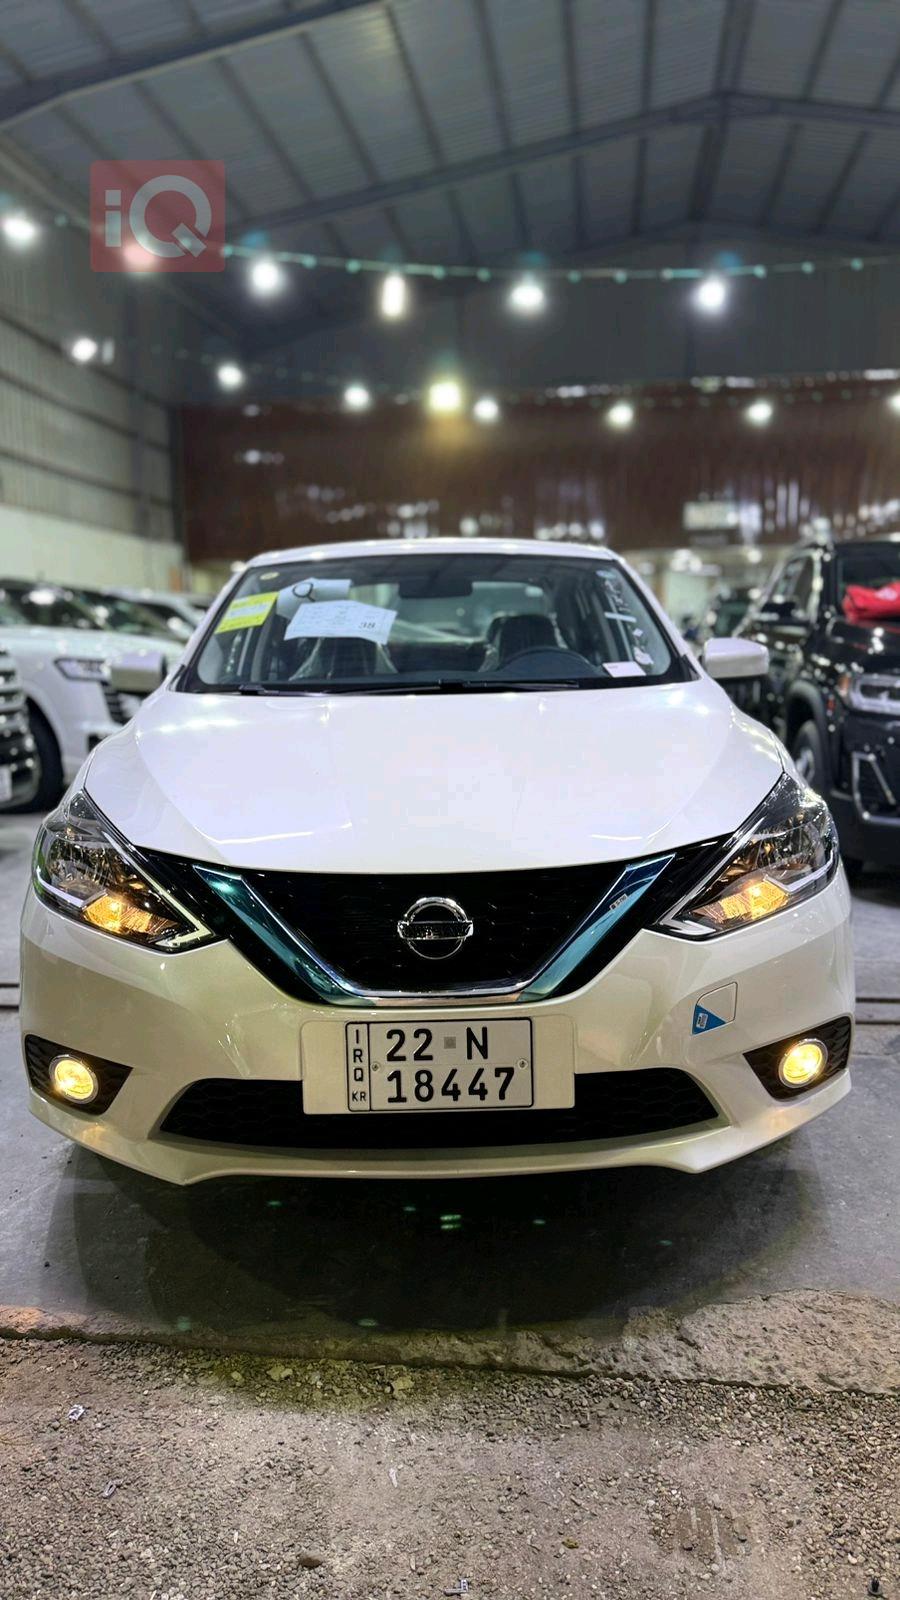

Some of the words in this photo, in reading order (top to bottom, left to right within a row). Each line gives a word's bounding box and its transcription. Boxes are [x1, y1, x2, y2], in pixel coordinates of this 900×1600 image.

[386, 1028, 433, 1062] 22
[466, 1026, 489, 1060] N
[351, 1091, 367, 1102] KR
[386, 1066, 515, 1103] 18447
